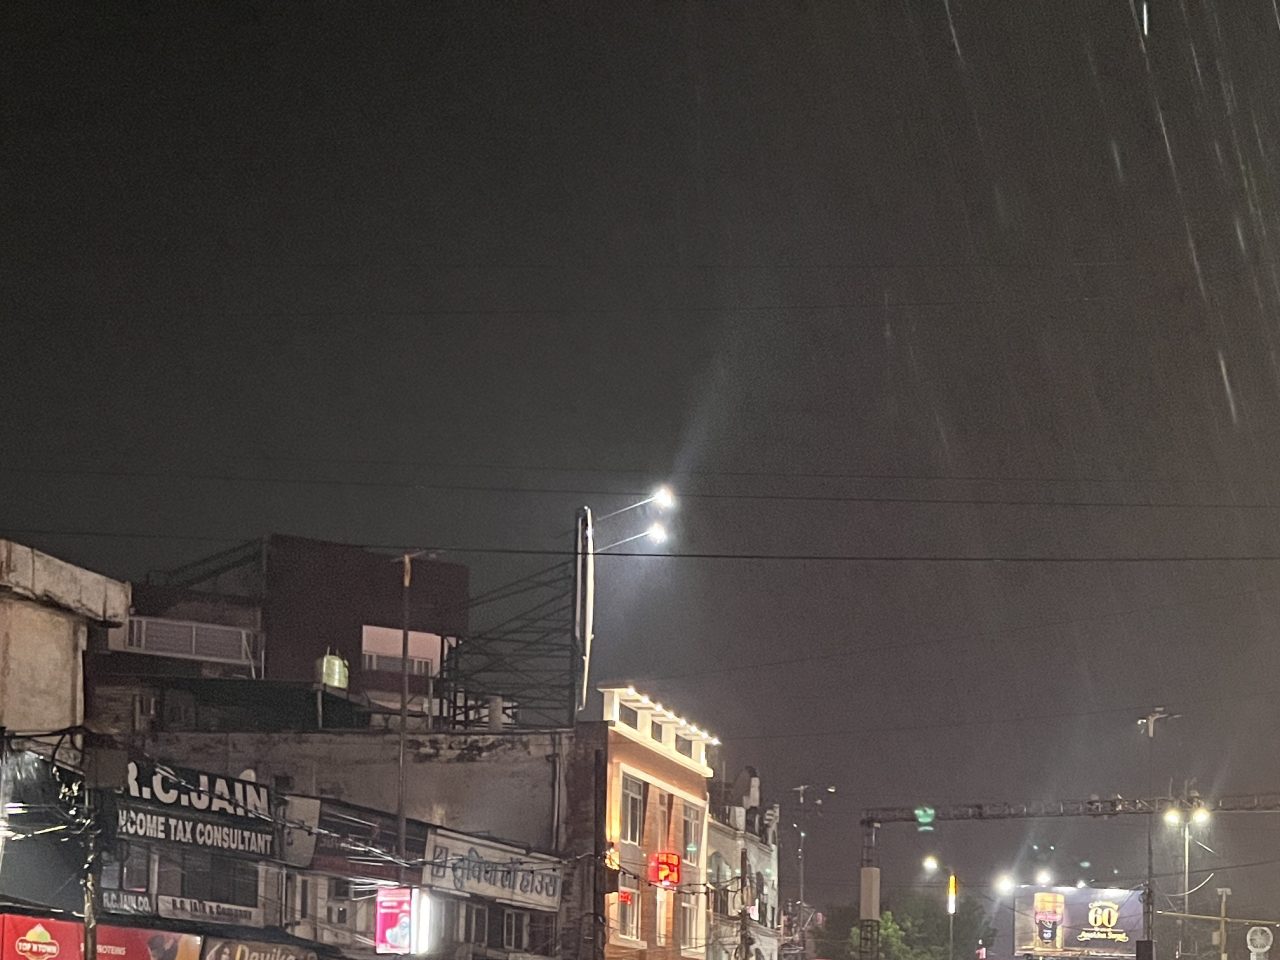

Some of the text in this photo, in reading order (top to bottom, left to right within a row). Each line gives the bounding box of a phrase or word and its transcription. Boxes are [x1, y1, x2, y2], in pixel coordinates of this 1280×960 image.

[117, 809, 273, 855] NCOME TAX CONSULTANT
[1088, 907, 1119, 928] 60
